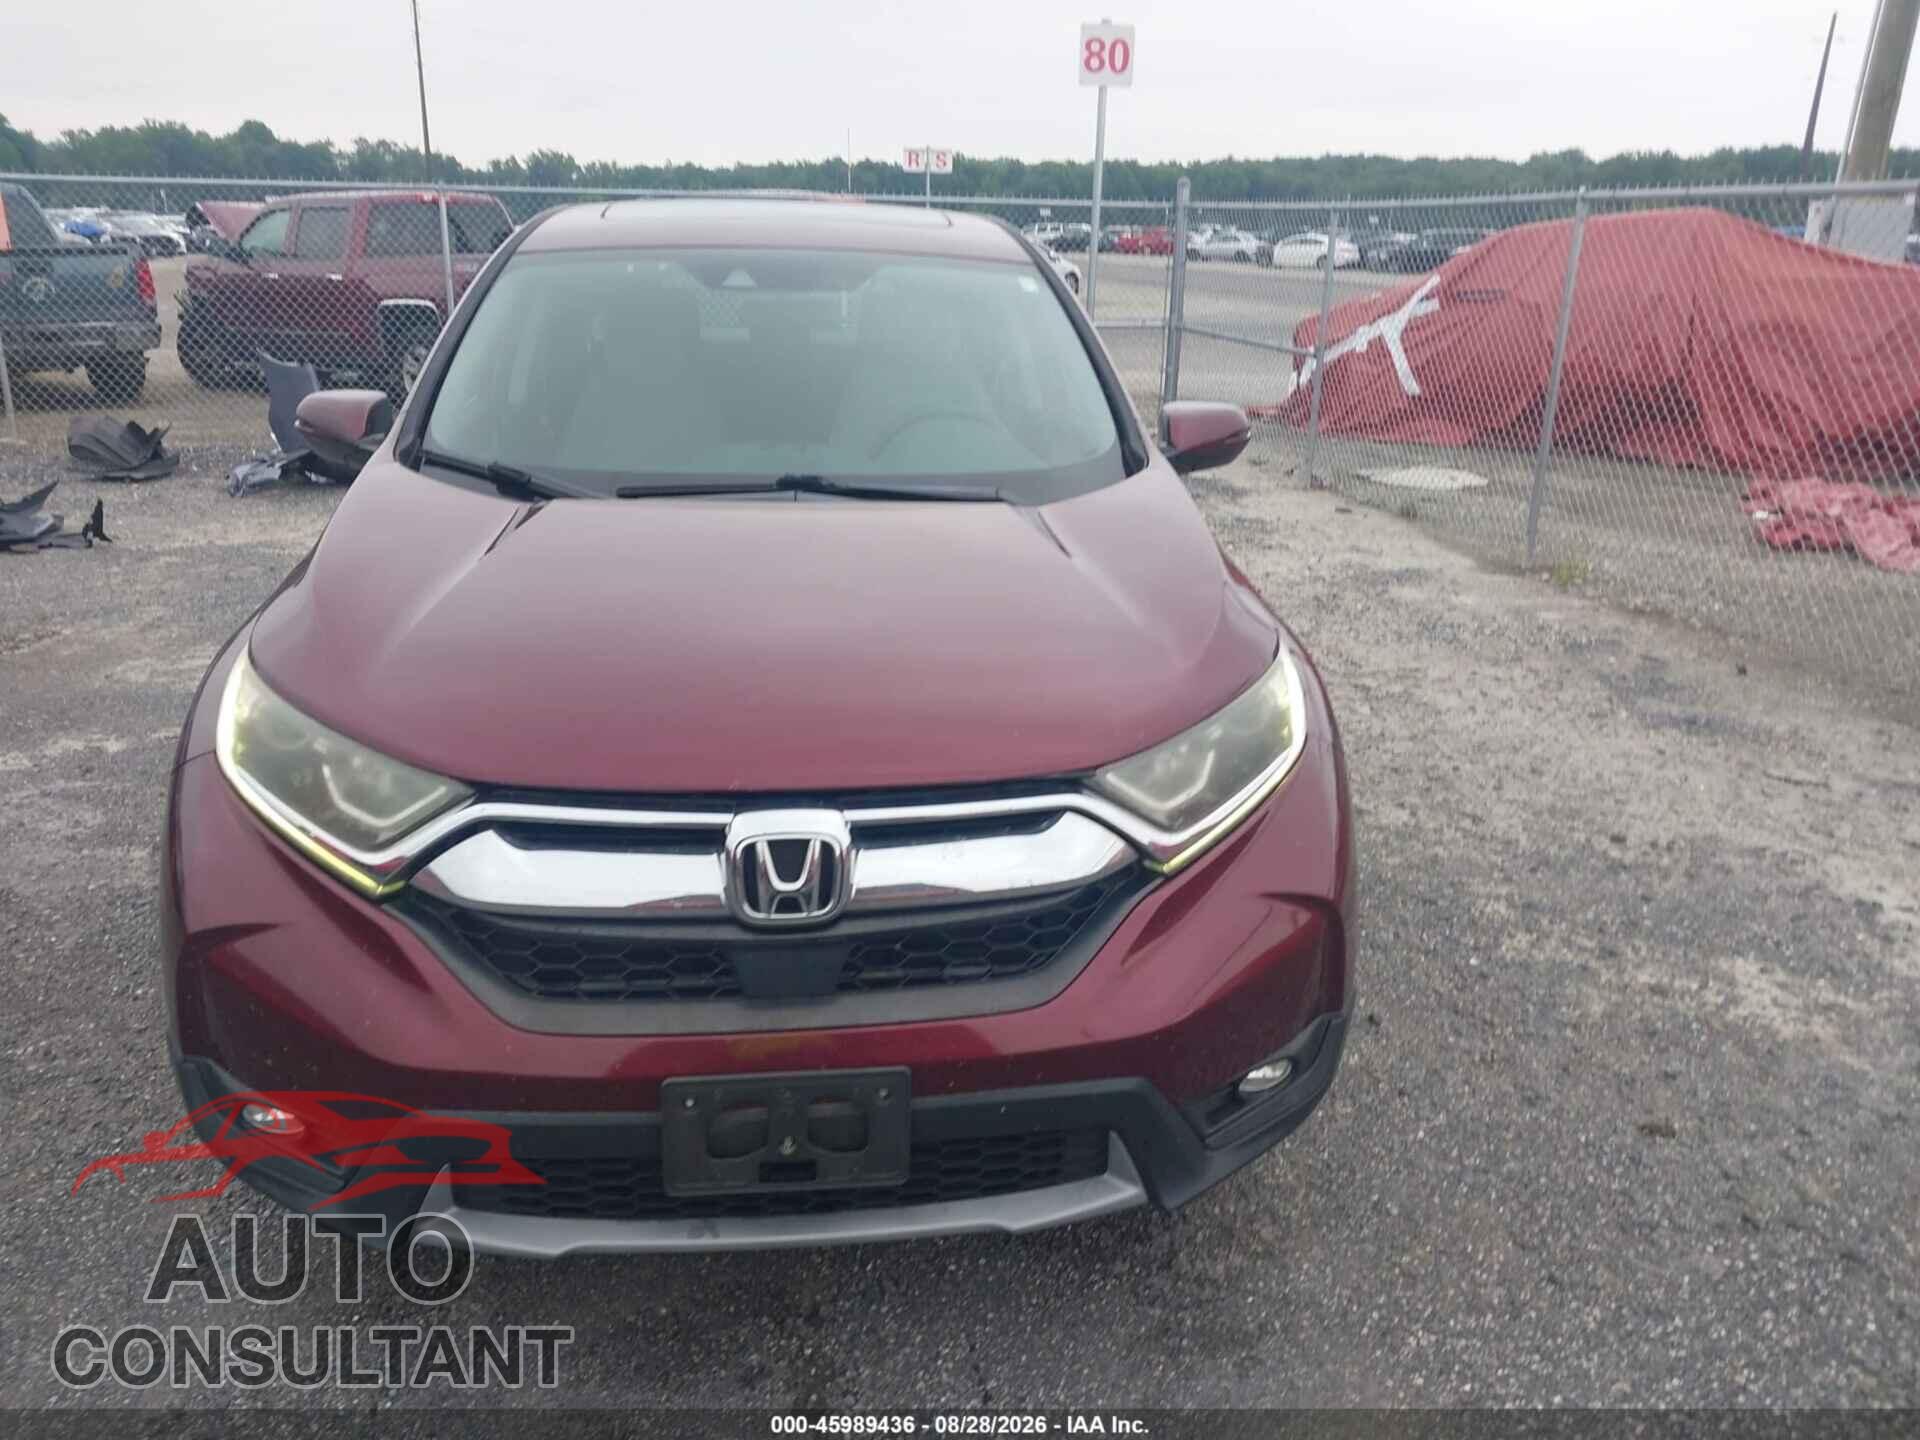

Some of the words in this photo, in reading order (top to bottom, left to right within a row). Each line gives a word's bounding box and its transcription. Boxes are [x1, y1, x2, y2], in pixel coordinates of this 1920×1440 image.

[1083, 37, 1130, 74] 80
[907, 151, 920, 168] R
[936, 151, 947, 168] S
